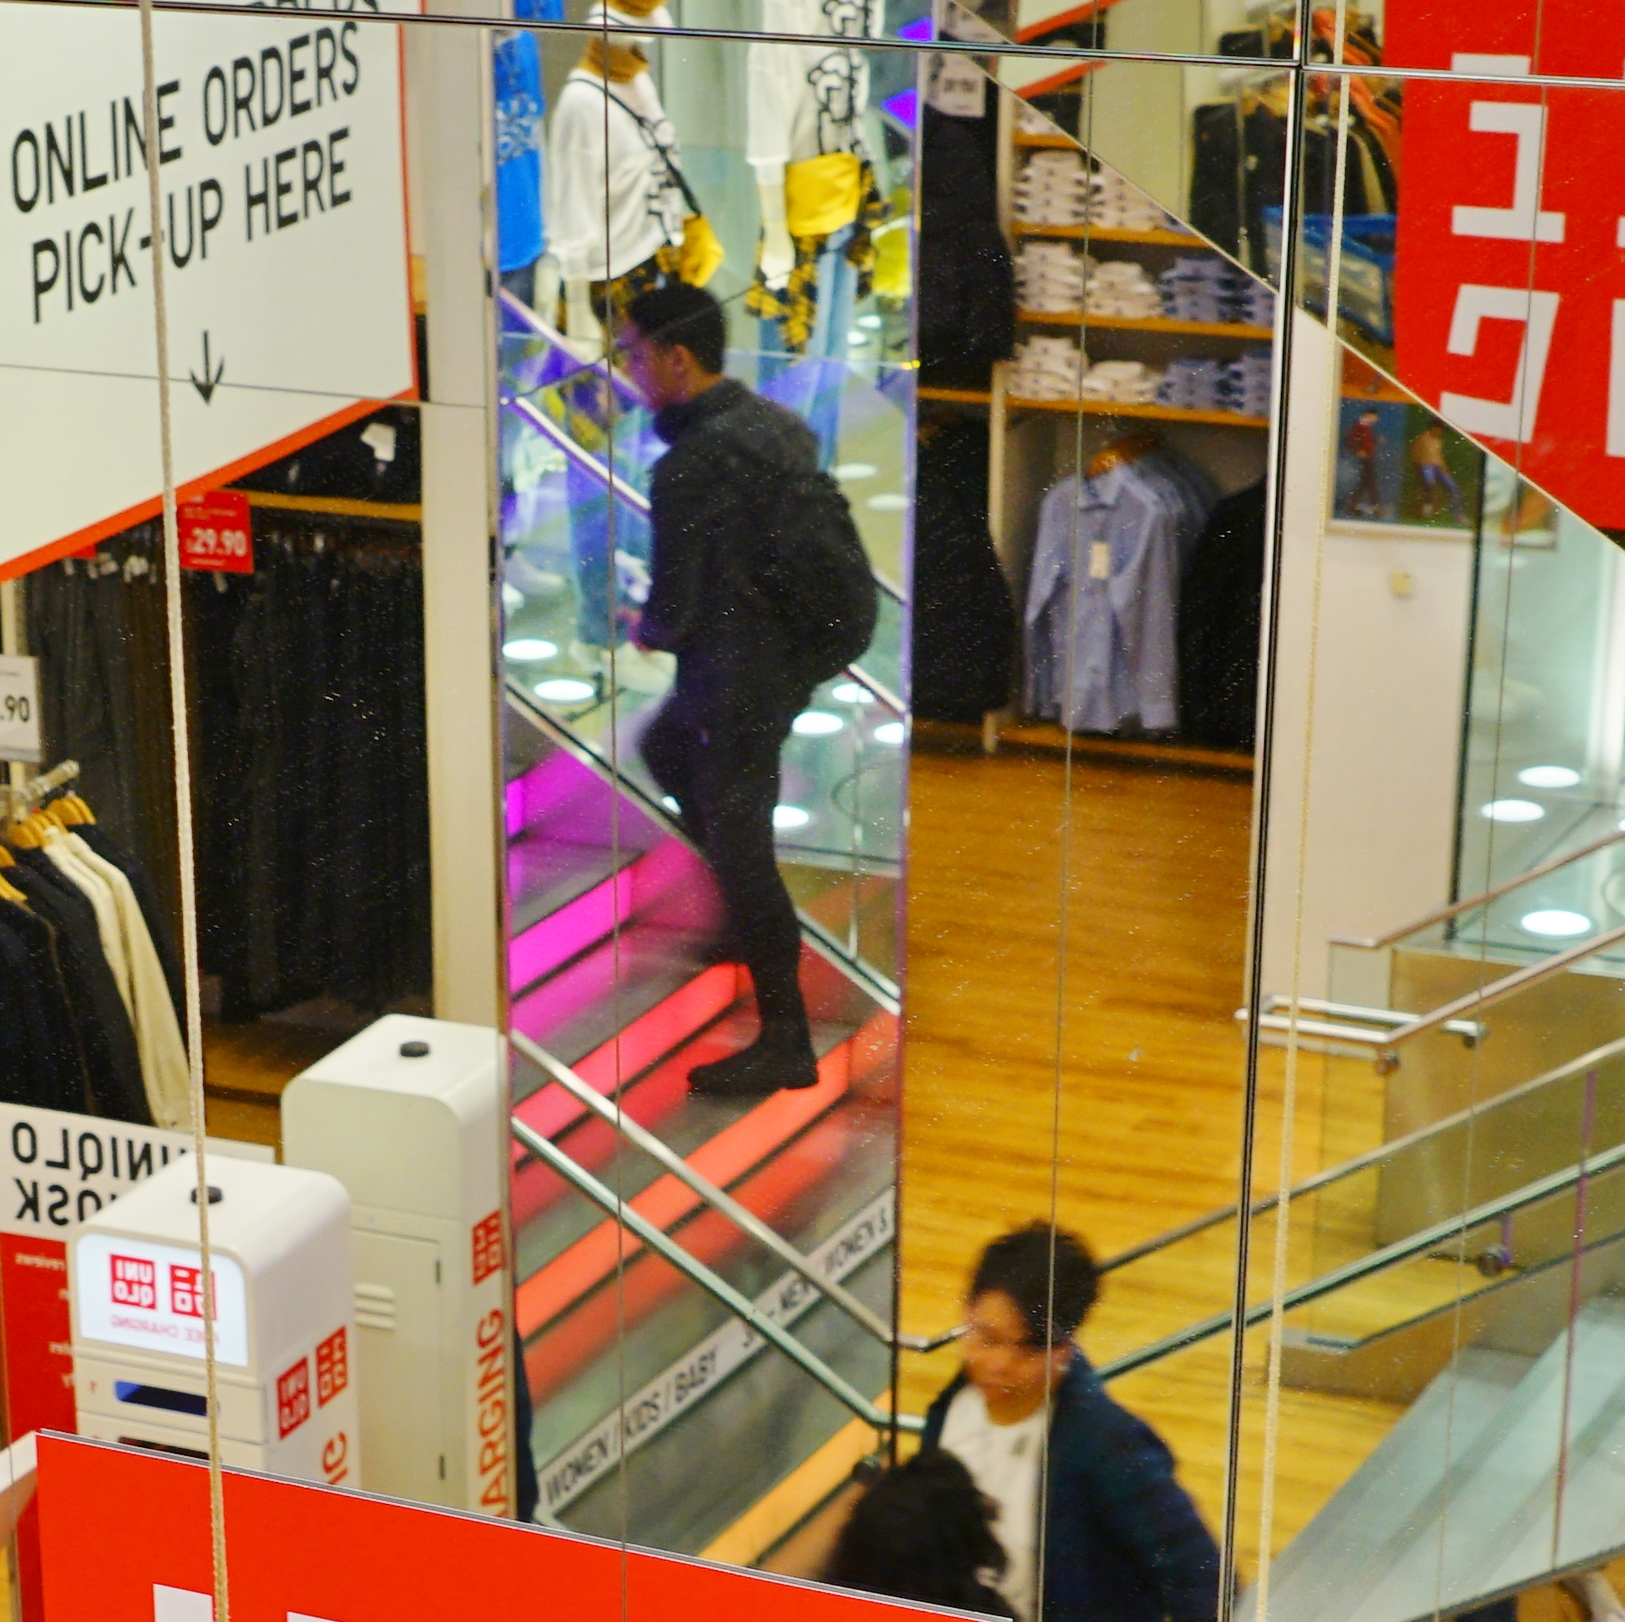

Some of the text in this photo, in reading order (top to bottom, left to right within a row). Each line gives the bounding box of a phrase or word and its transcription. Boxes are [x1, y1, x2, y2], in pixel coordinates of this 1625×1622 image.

[11, 21, 360, 213] ONLINE ORDERS
[32, 126, 351, 324] PICK-UP HERE
[478, 1308, 507, 1518] ARGING
